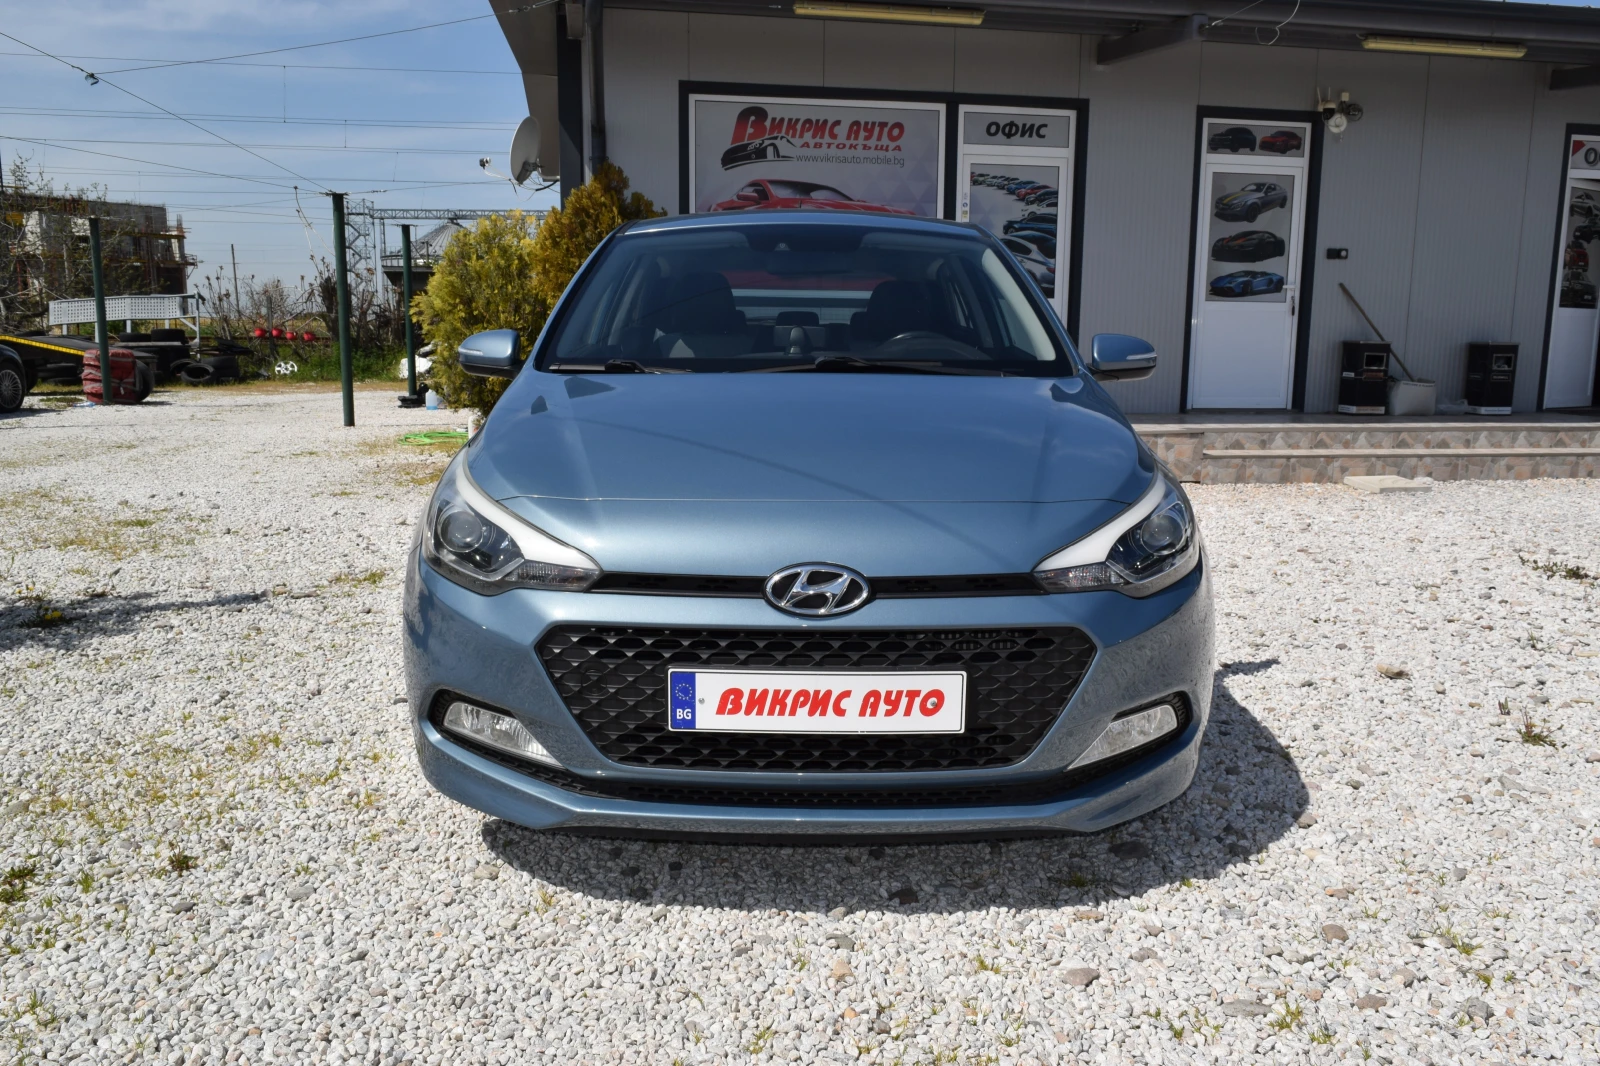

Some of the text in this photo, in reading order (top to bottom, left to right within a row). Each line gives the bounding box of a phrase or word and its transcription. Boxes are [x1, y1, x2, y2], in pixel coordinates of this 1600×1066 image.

[845, 119, 905, 143] АУТО
[985, 120, 1049, 140] ОФИС
[799, 141, 902, 153] АВТОКЪЩА
[795, 153, 905, 168] www.vikrisauto.mobile.bg
[715, 687, 945, 717] ВИКРИС АУТО
[676, 708, 692, 720] BG
